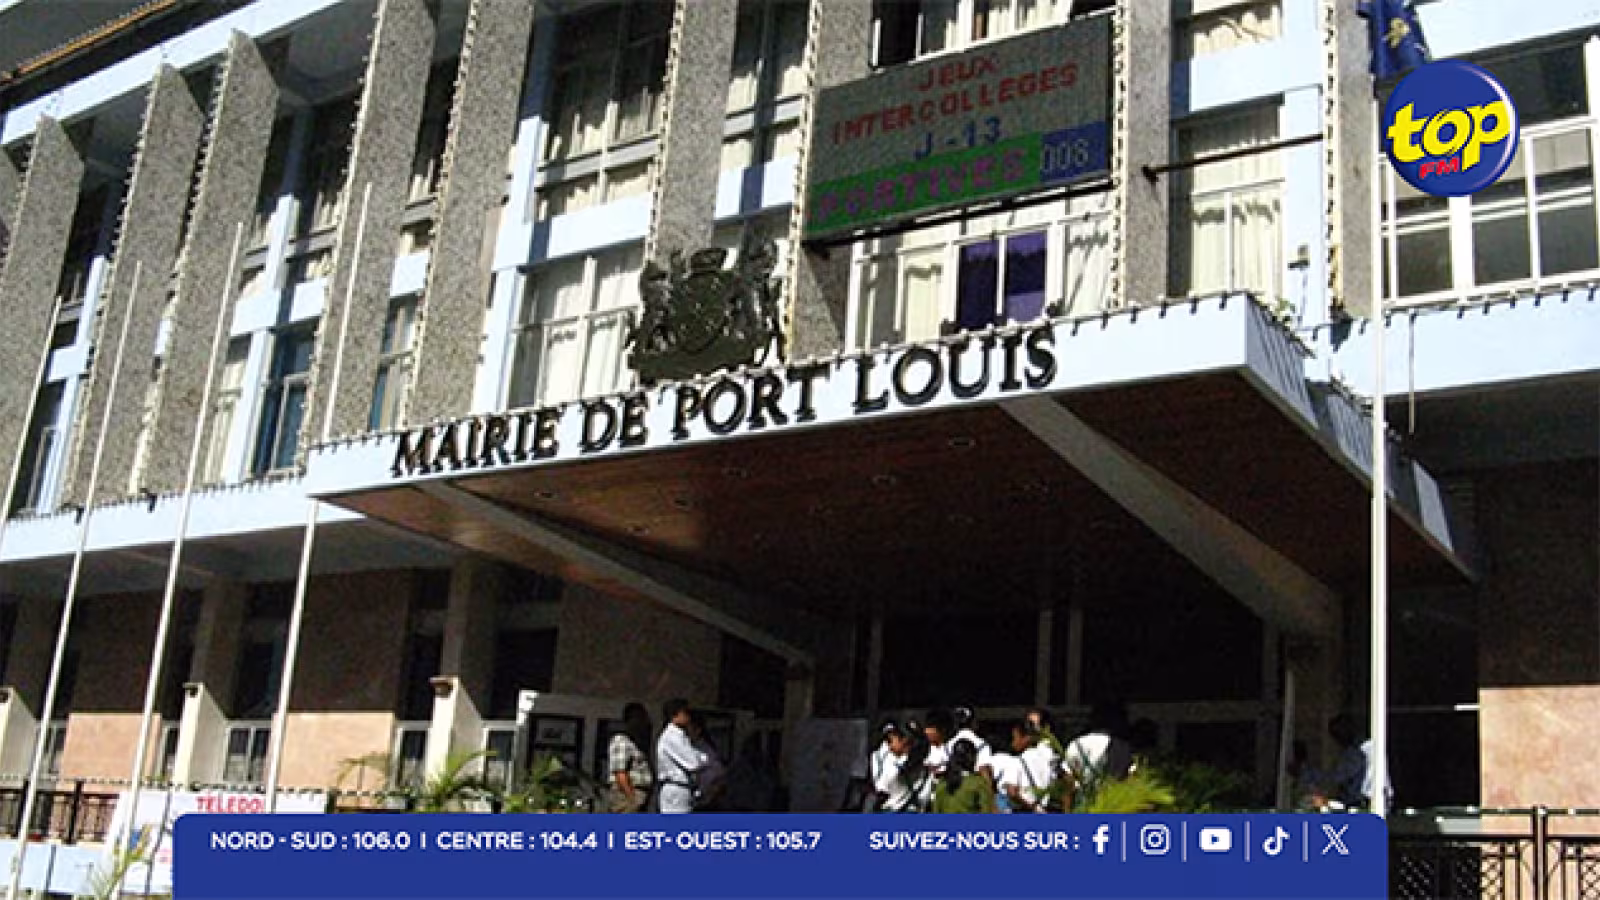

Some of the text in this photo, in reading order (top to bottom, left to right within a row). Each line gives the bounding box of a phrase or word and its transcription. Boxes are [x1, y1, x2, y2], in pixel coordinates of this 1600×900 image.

[834, 62, 1078, 145] INTERCOLLEGES
[919, 57, 996, 91] JEUX
[806, 149, 1025, 222] PORTIVES
[391, 327, 1056, 478] MAIRIE DE PORT LOUIS
